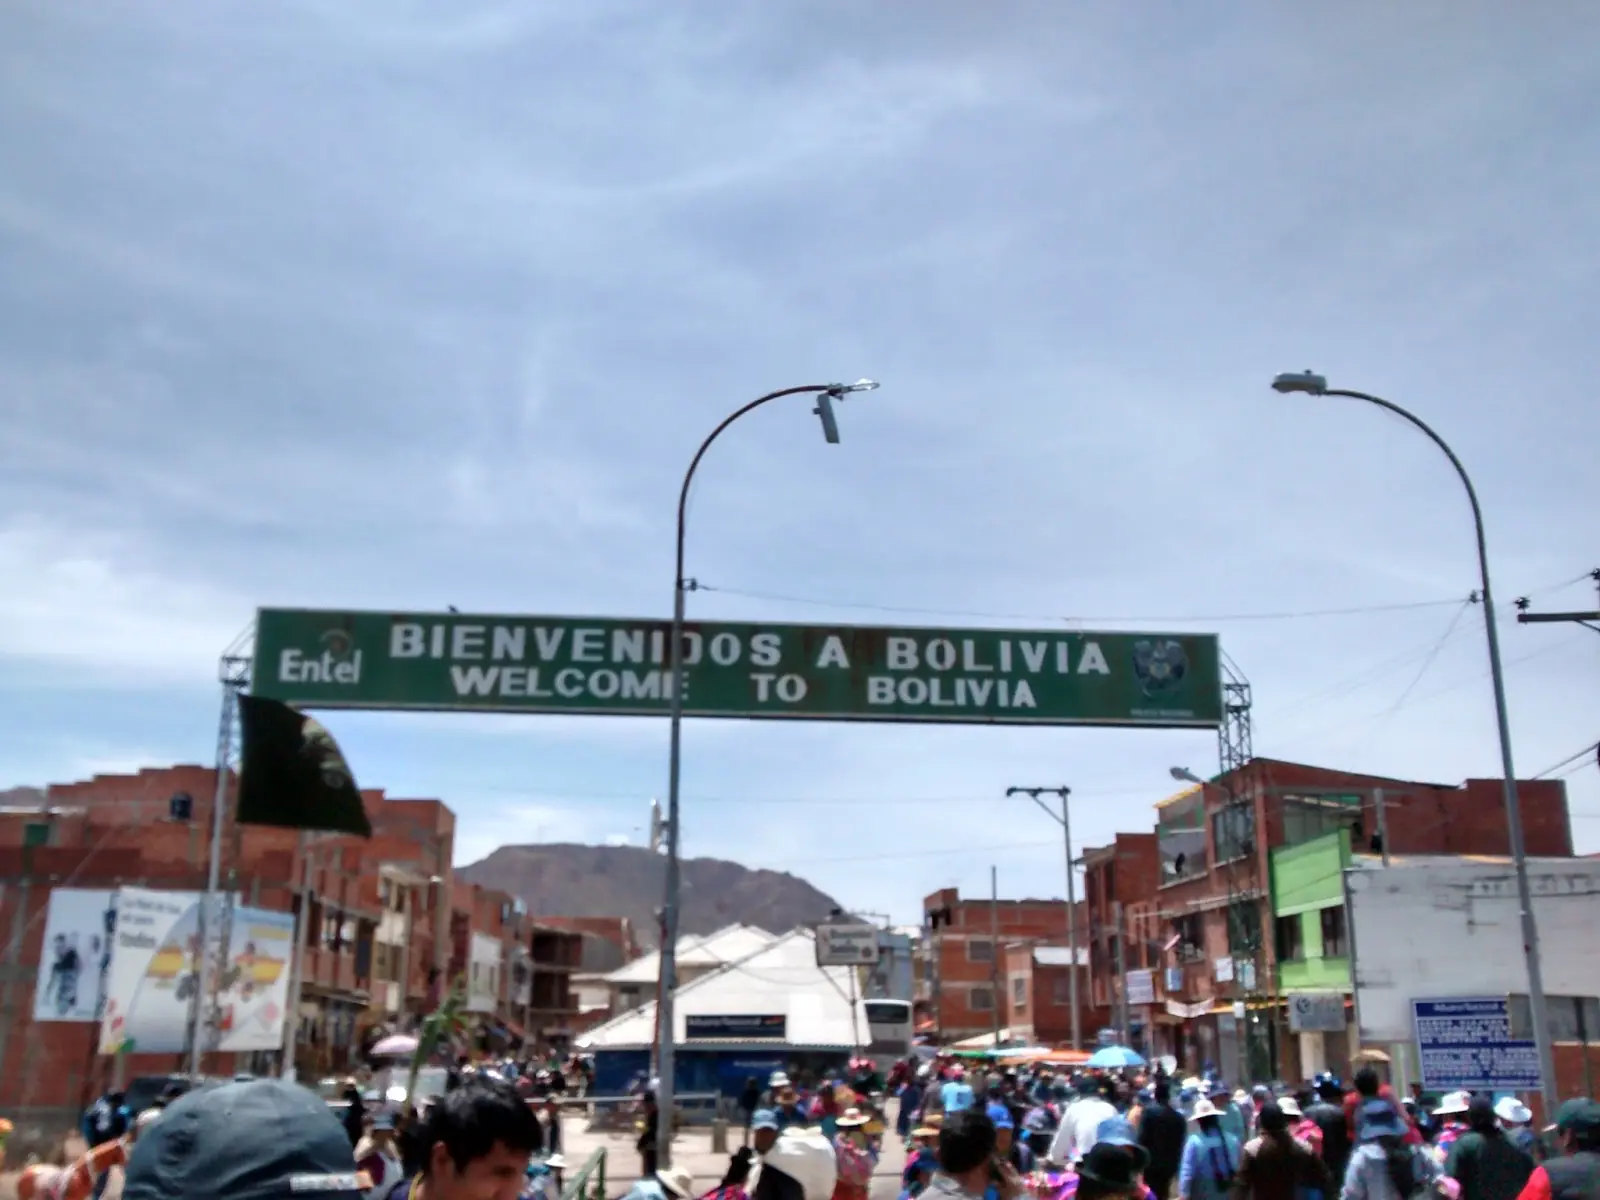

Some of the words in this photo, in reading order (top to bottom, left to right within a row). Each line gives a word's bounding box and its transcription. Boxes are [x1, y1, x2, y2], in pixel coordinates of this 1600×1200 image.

[280, 648, 362, 683] Entel
[390, 623, 782, 667] BIENVENIDOS
[816, 635, 850, 668] A
[887, 637, 1110, 675] BOLIVIA
[450, 665, 689, 701] WELCOME
[750, 672, 808, 702] TO
[868, 676, 1037, 709] BOLIVIA
